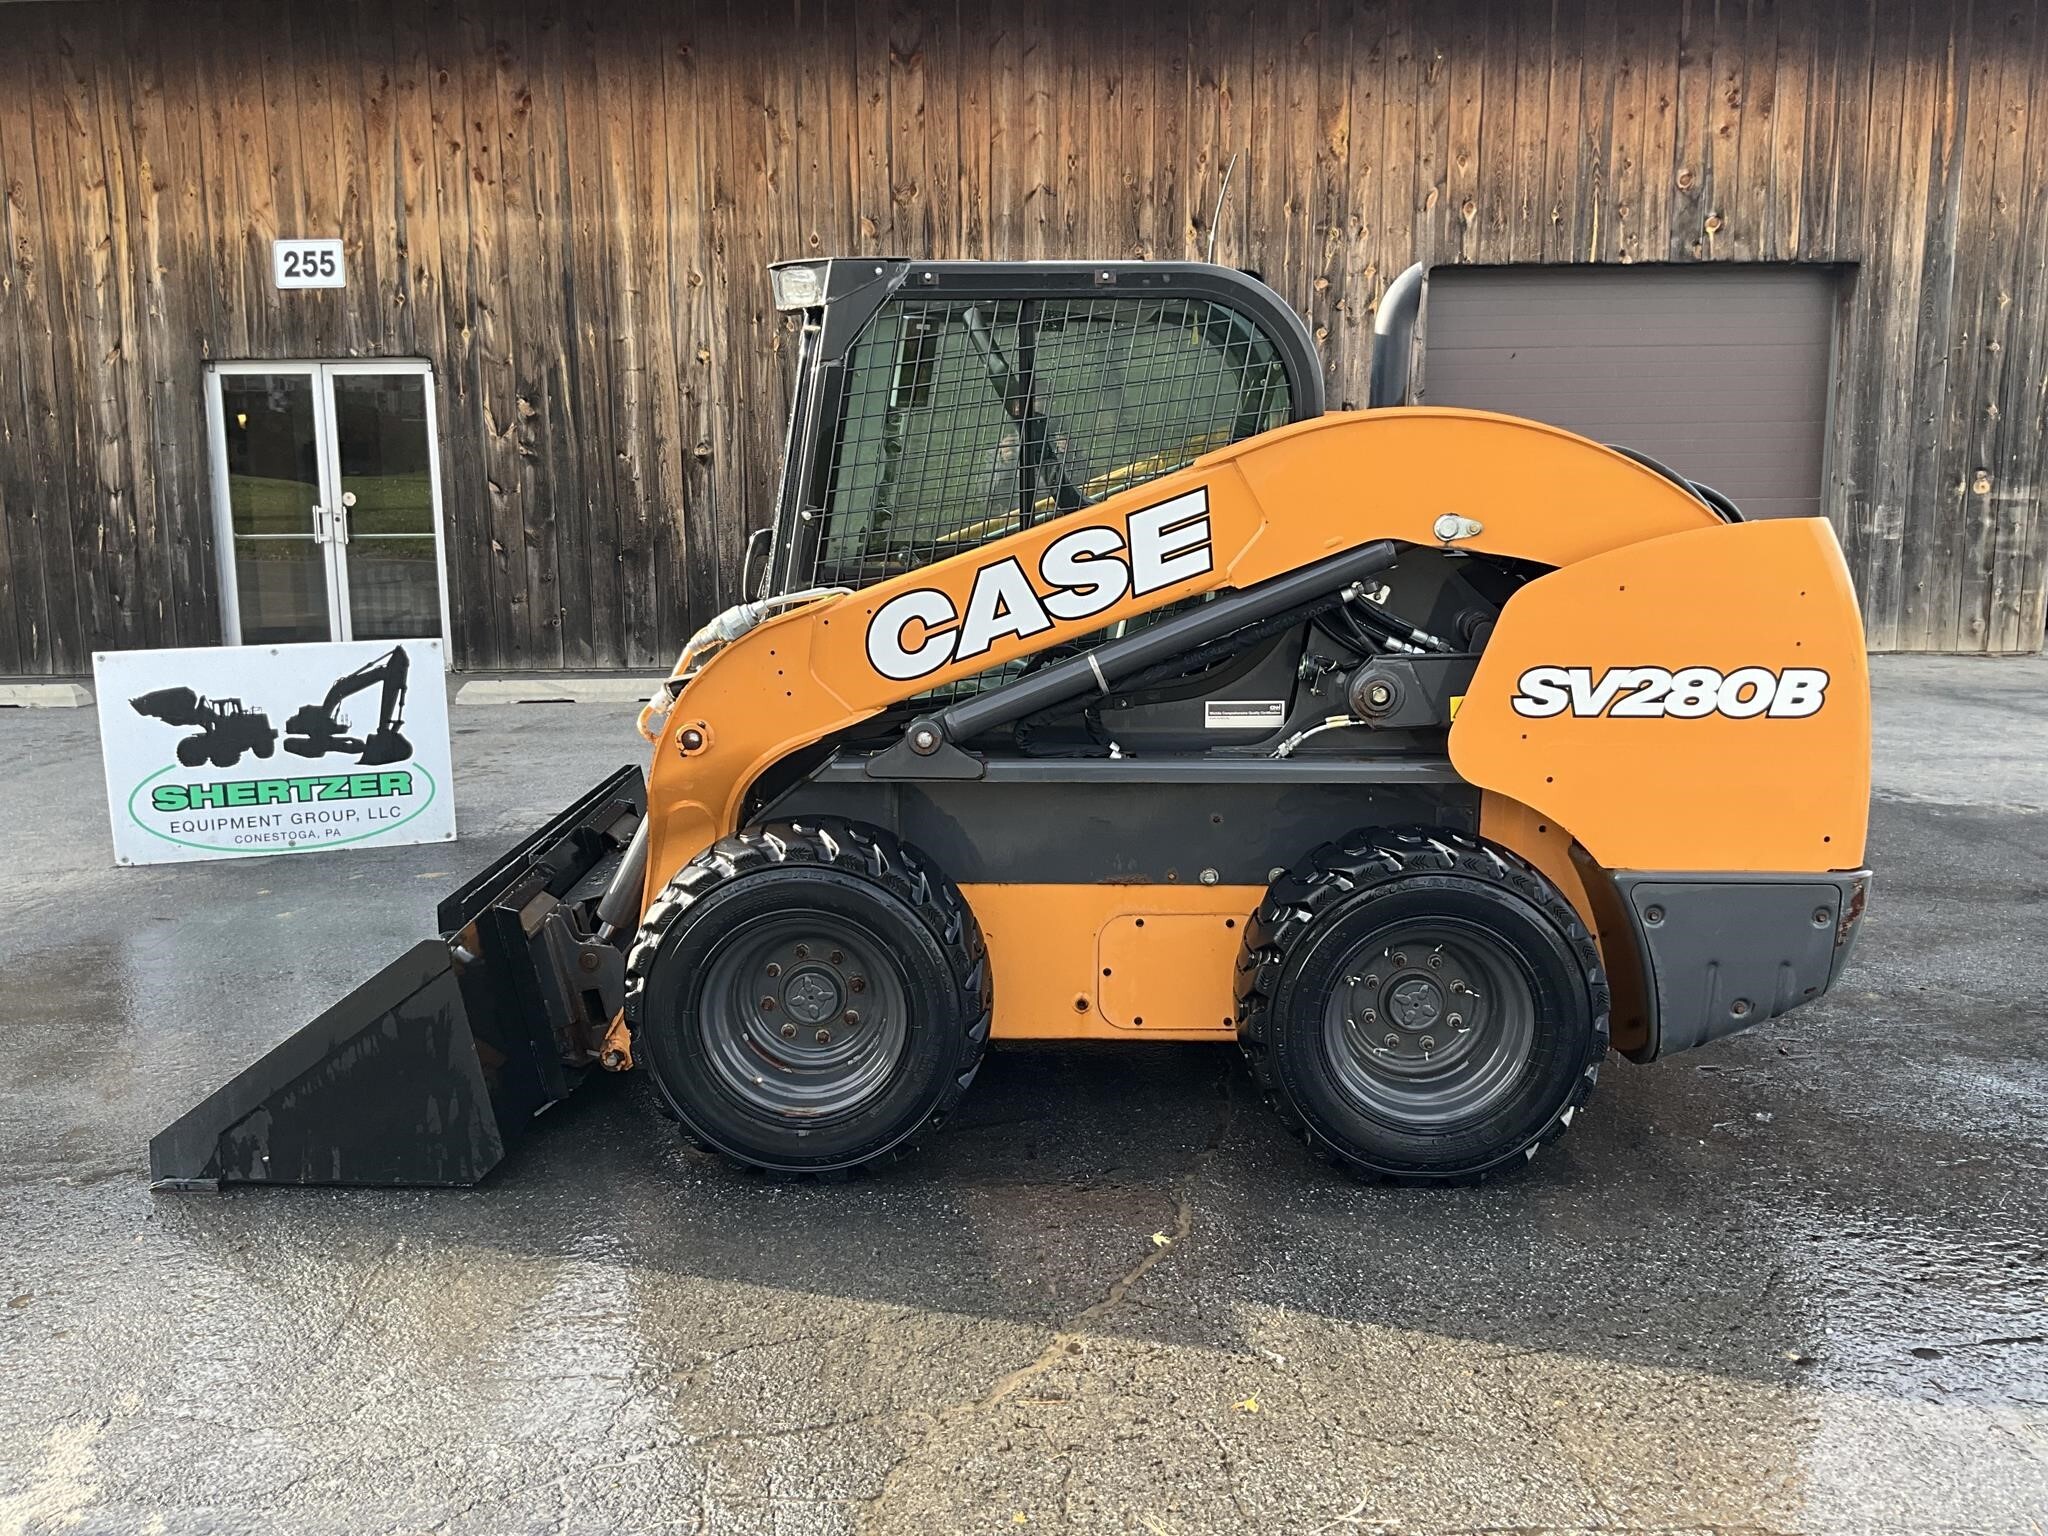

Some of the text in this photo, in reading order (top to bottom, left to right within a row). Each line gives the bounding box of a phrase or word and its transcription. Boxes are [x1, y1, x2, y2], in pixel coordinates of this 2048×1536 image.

[284, 250, 336, 278] 255
[865, 485, 1214, 681] CASE
[1510, 664, 1830, 719] SV280B
[152, 771, 412, 811] SHERTZER
[170, 806, 401, 834] EQUIPMENT GROUP, LLC
[235, 828, 341, 843] CONESTOGA, PA
